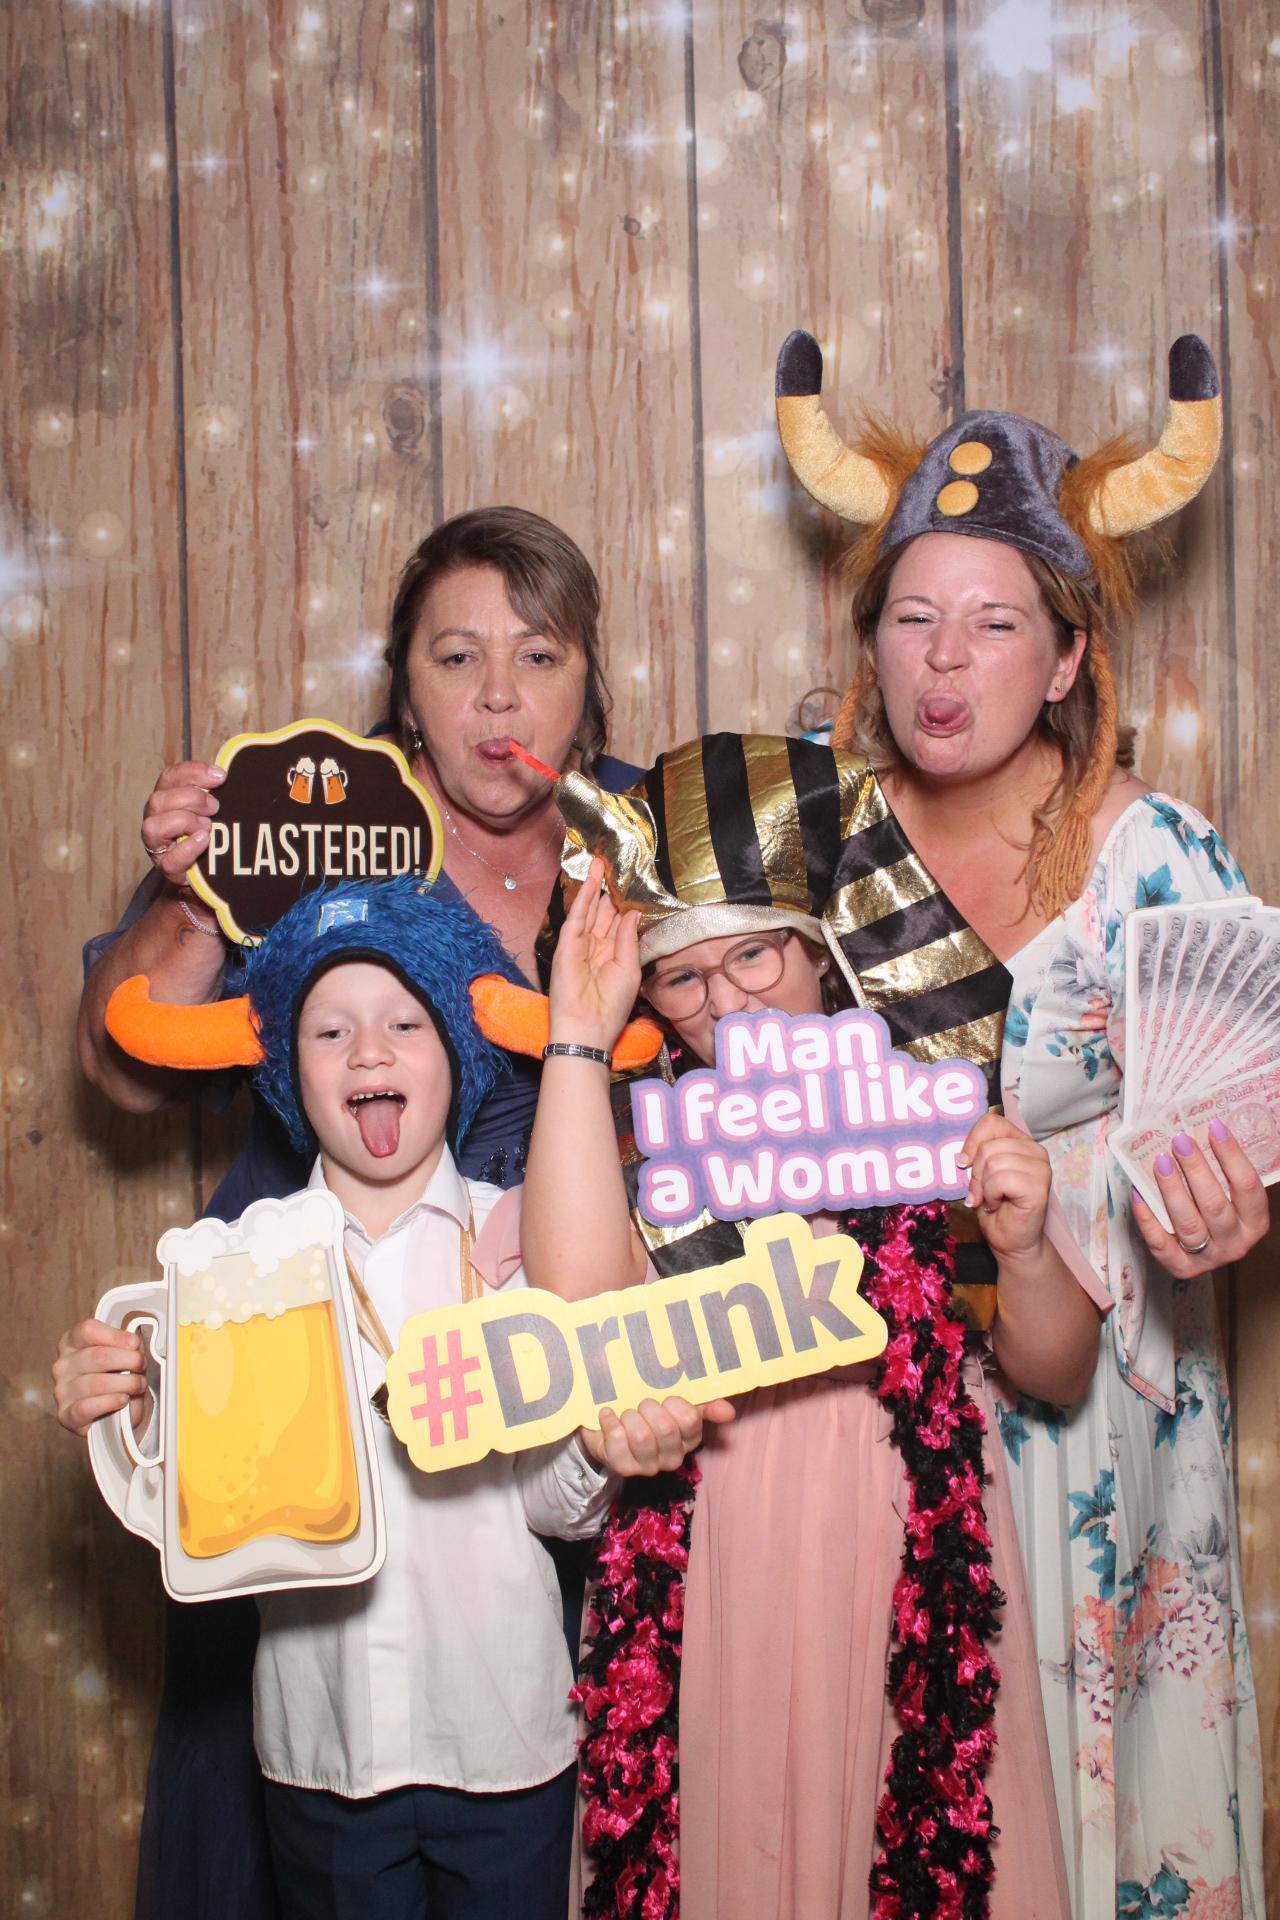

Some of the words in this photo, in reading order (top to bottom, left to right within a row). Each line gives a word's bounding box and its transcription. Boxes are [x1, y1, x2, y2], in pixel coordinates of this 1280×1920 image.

[208, 822, 422, 876] PLASTERED!
[728, 1022, 879, 1077] Man
[644, 1093, 665, 1144] I
[684, 1073, 825, 1141] feel
[843, 1063, 975, 1125] like
[651, 1169, 690, 1212] a
[408, 1237, 865, 1447] #Drunk
